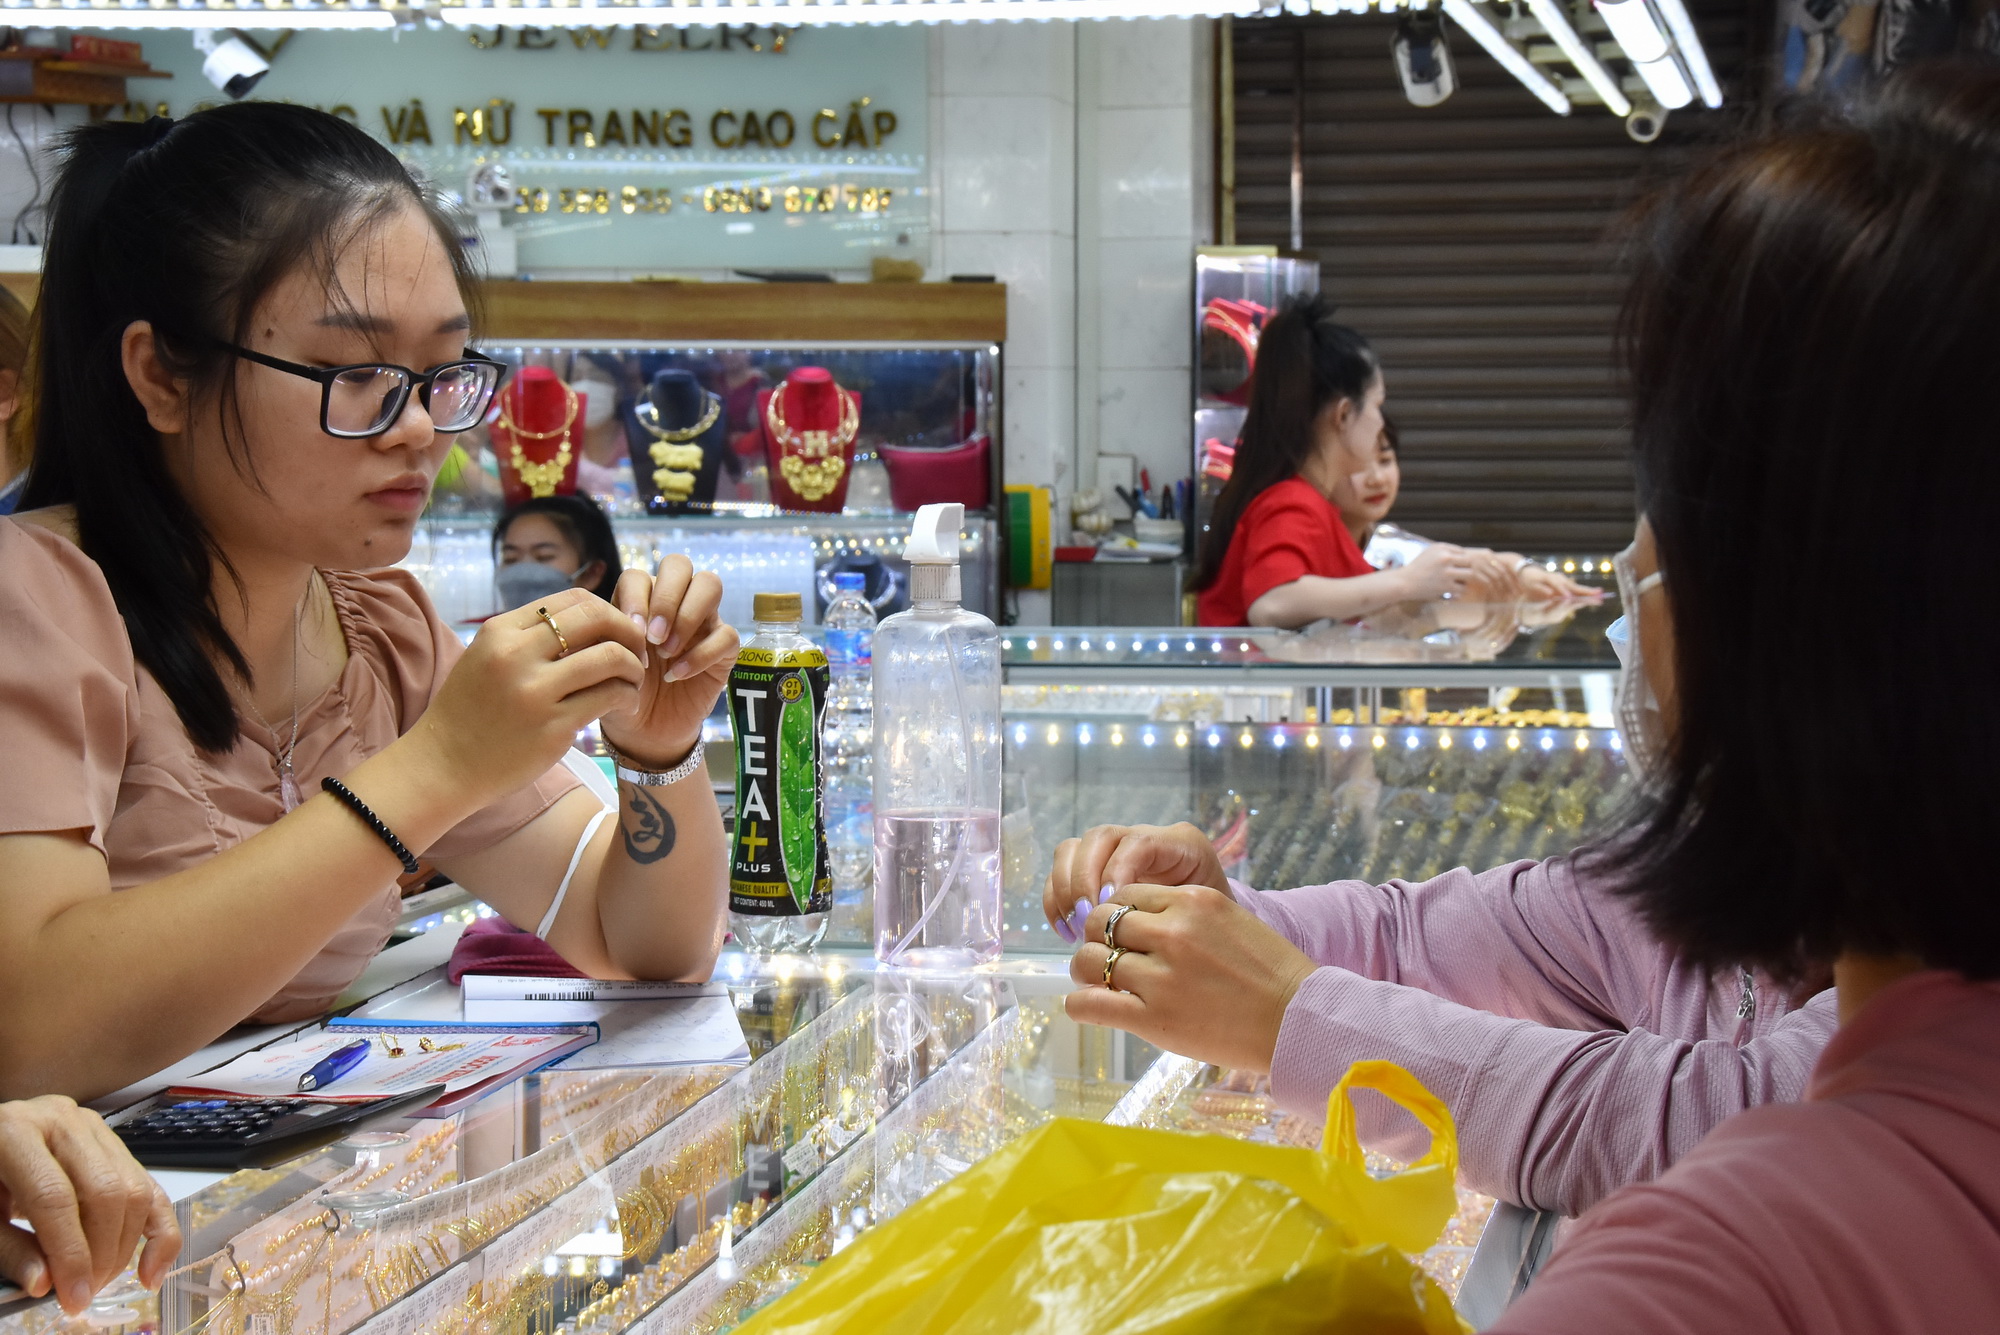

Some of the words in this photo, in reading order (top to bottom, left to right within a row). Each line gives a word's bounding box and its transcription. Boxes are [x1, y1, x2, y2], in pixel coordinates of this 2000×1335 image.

[467, 20, 800, 52] JEWELRY
[380, 98, 432, 145] VÀ
[454, 98, 516, 146] NỮ
[537, 108, 693, 147] TRANG
[710, 108, 795, 147] CAO
[812, 96, 897, 148] CẤP
[734, 671, 774, 681] SUNTORY
[736, 862, 771, 873] PLUS
[753, 885, 779, 894] QUALITY
